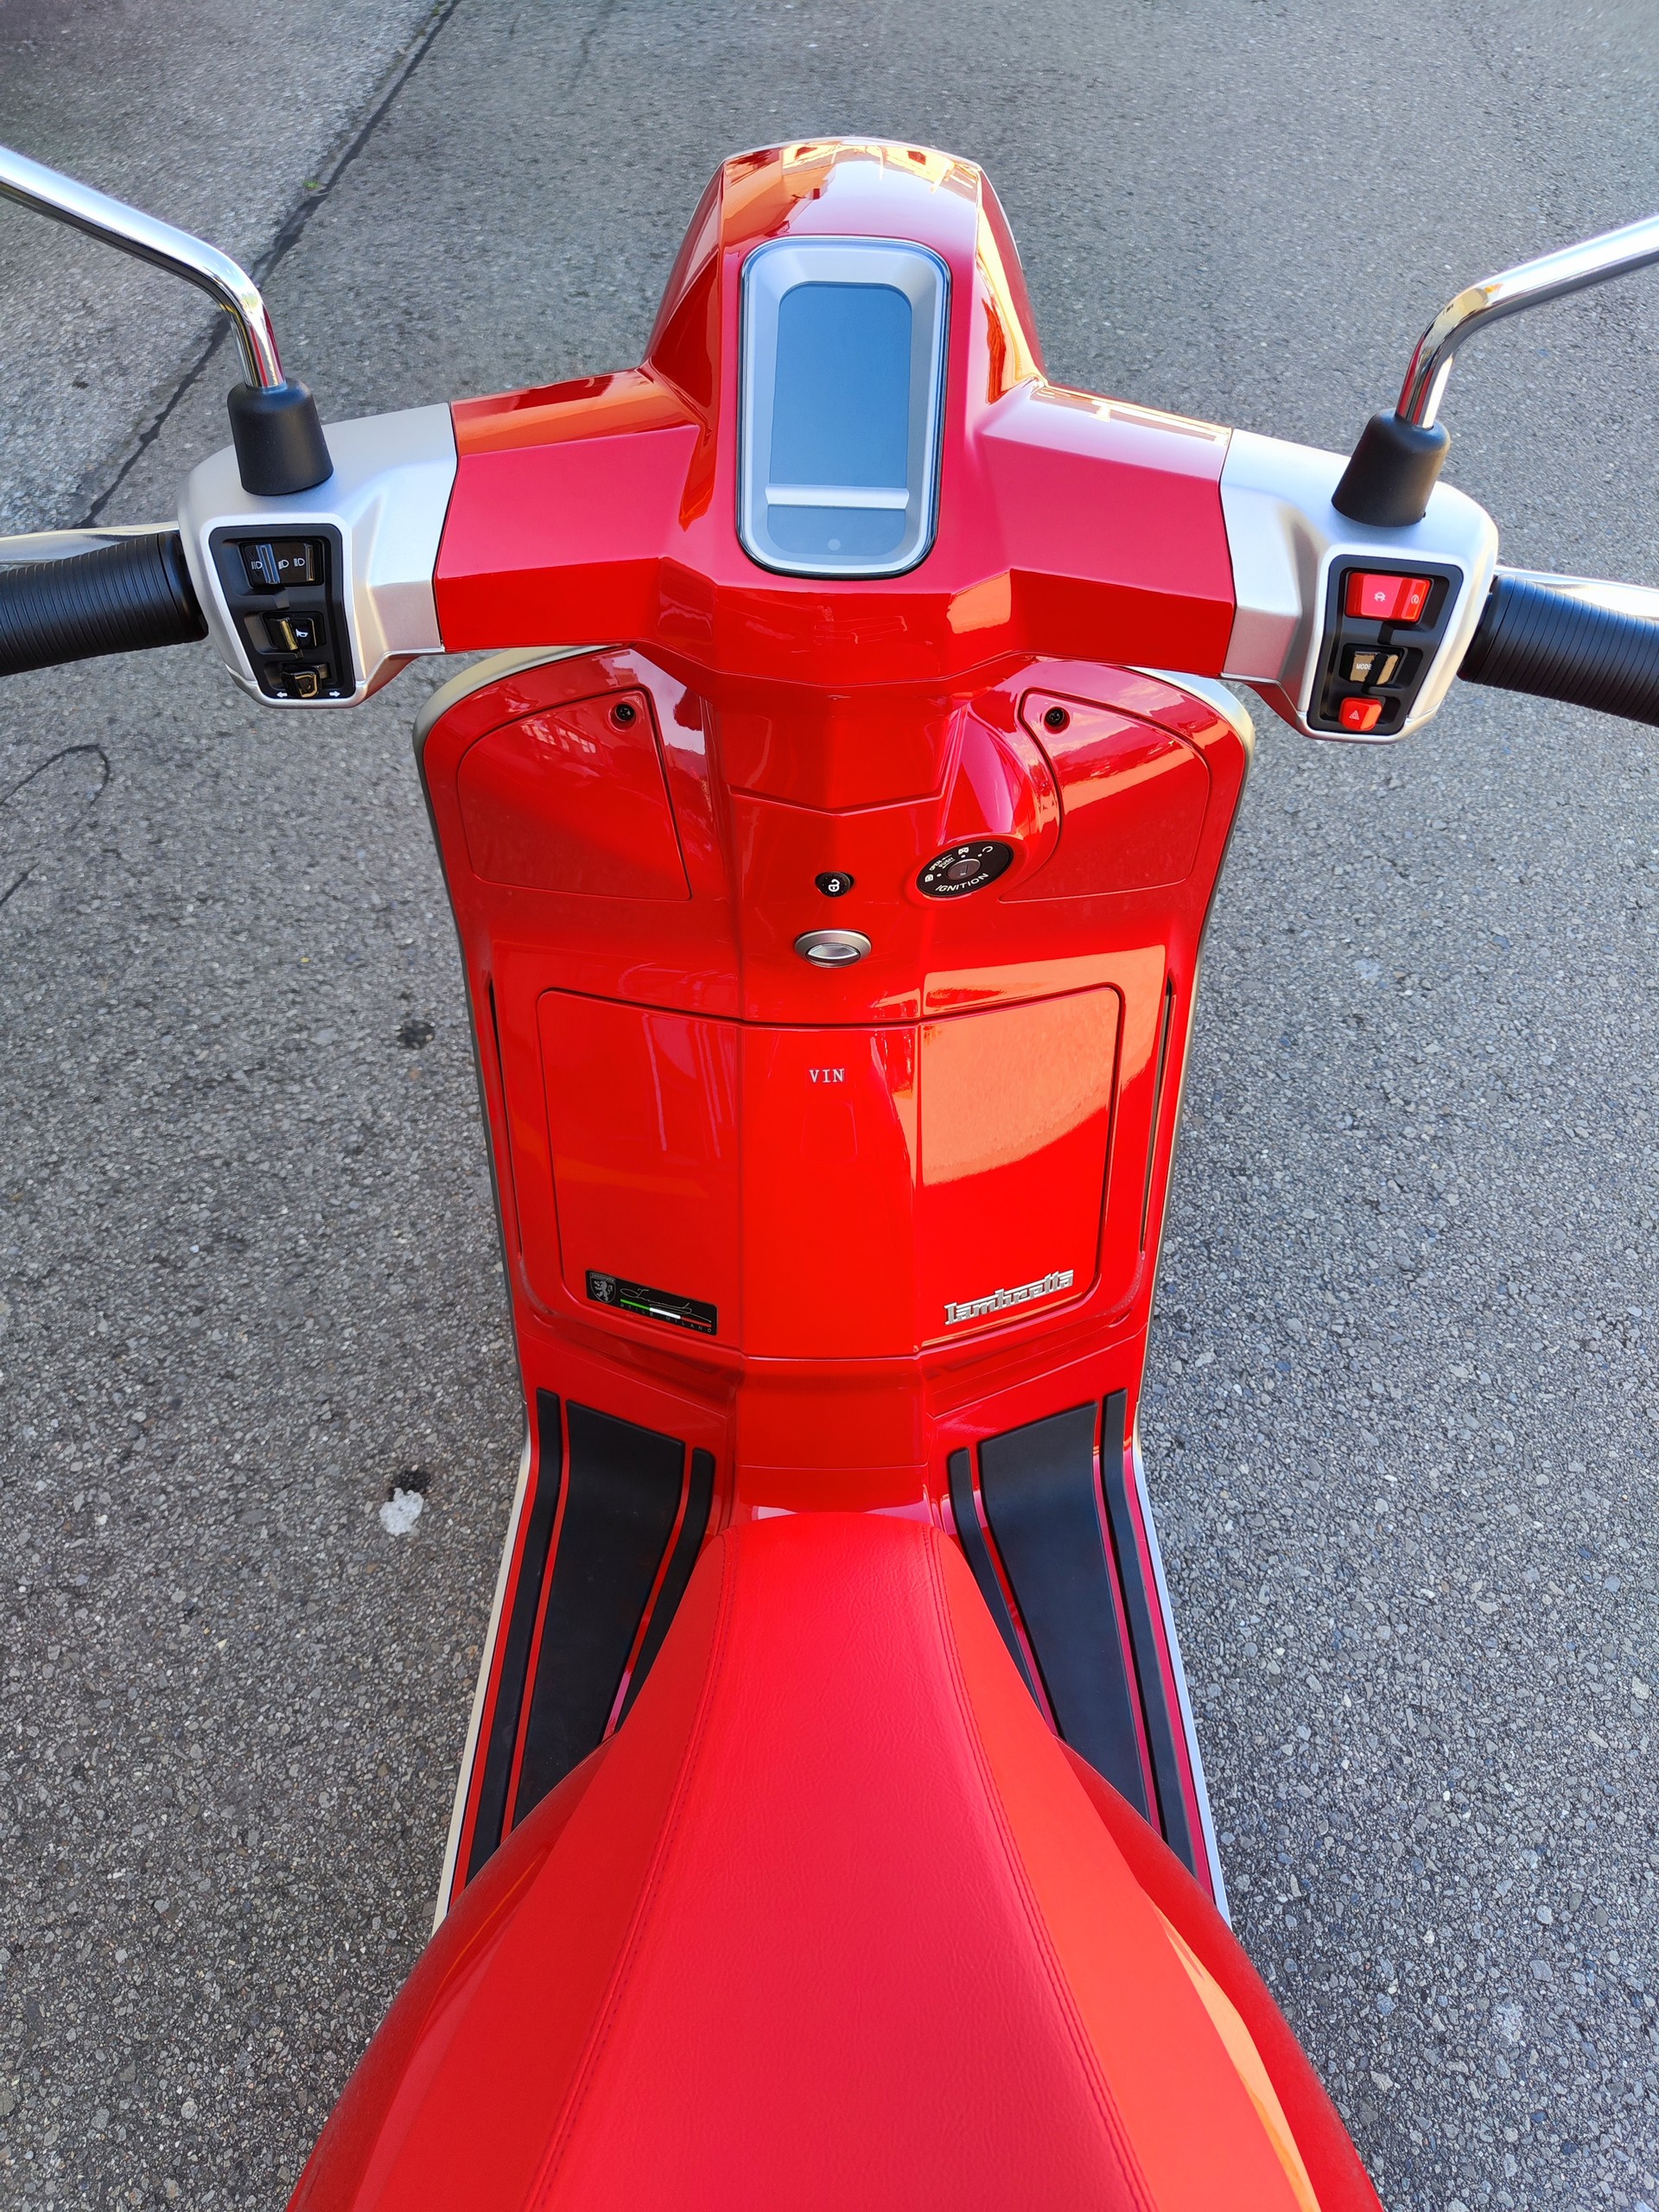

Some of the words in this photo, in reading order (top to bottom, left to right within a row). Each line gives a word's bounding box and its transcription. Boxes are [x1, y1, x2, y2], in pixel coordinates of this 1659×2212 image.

[935, 873, 989, 892] IGNITION
[809, 1068, 845, 1084] VIN
[665, 1316, 712, 1332] MILANO
